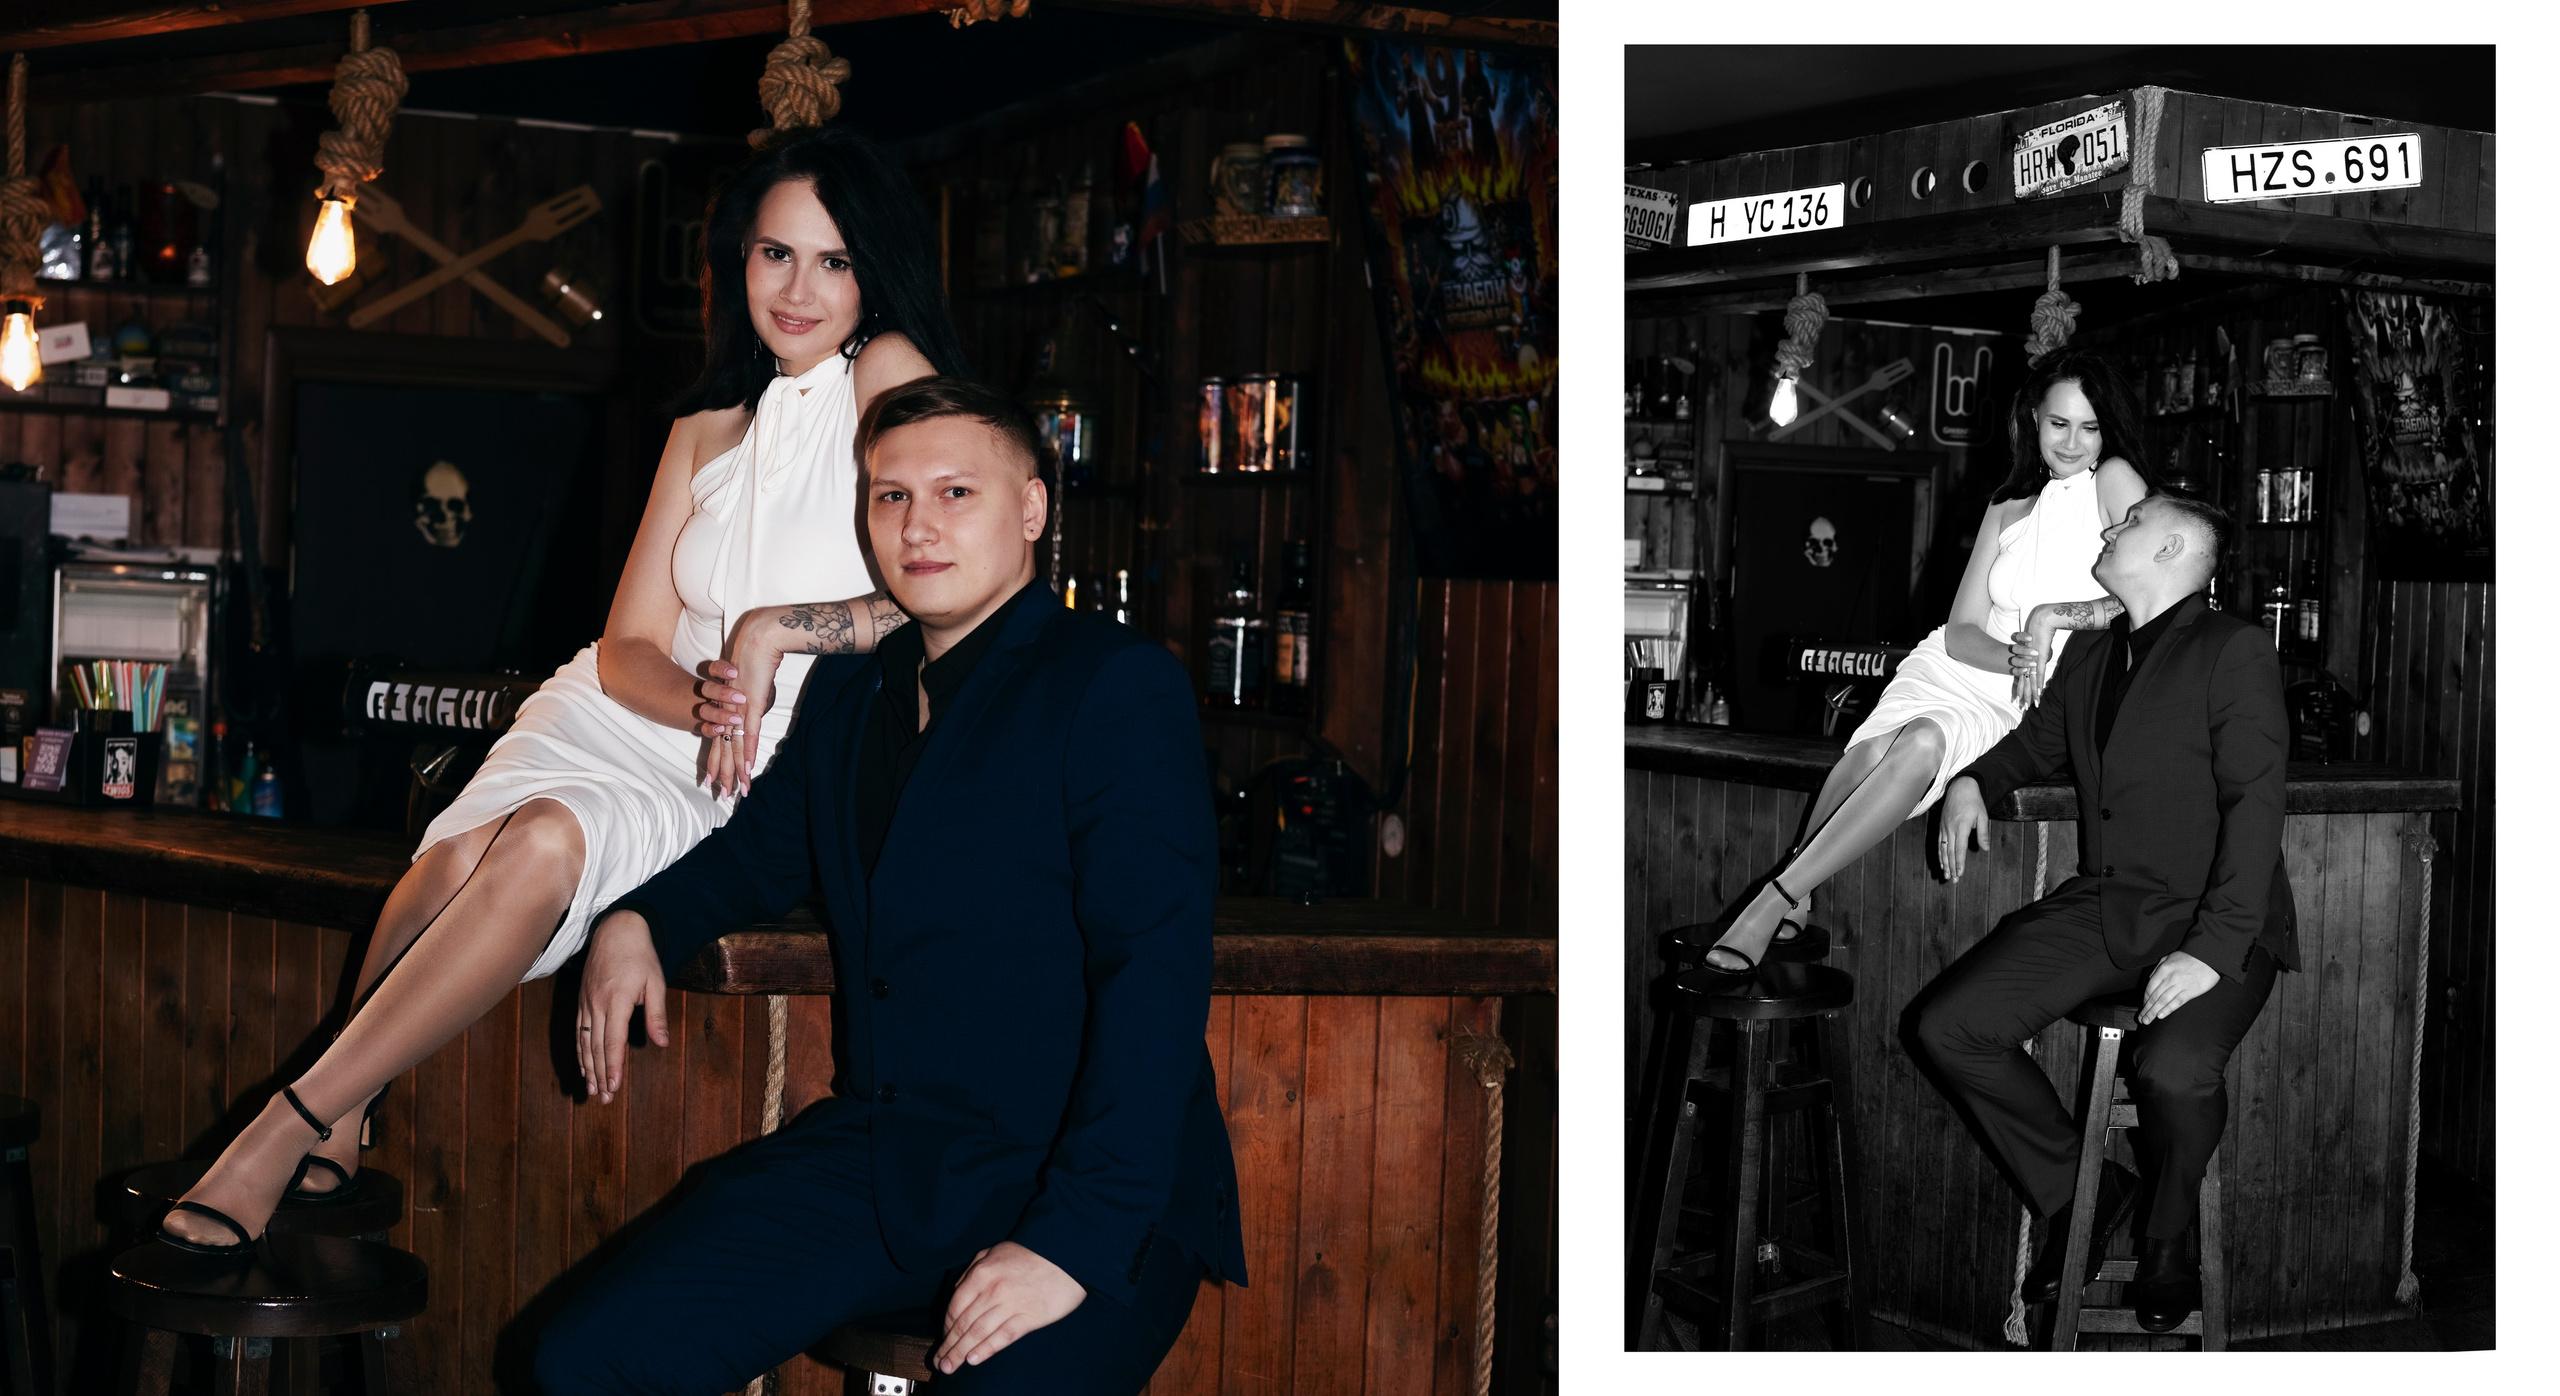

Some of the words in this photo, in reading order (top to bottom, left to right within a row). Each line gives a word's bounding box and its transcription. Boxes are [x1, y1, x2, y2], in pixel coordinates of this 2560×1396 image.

[2041, 113, 2095, 138] FLORIDA
[2020, 144, 2056, 186] HRW
[2083, 124, 2120, 166] 051
